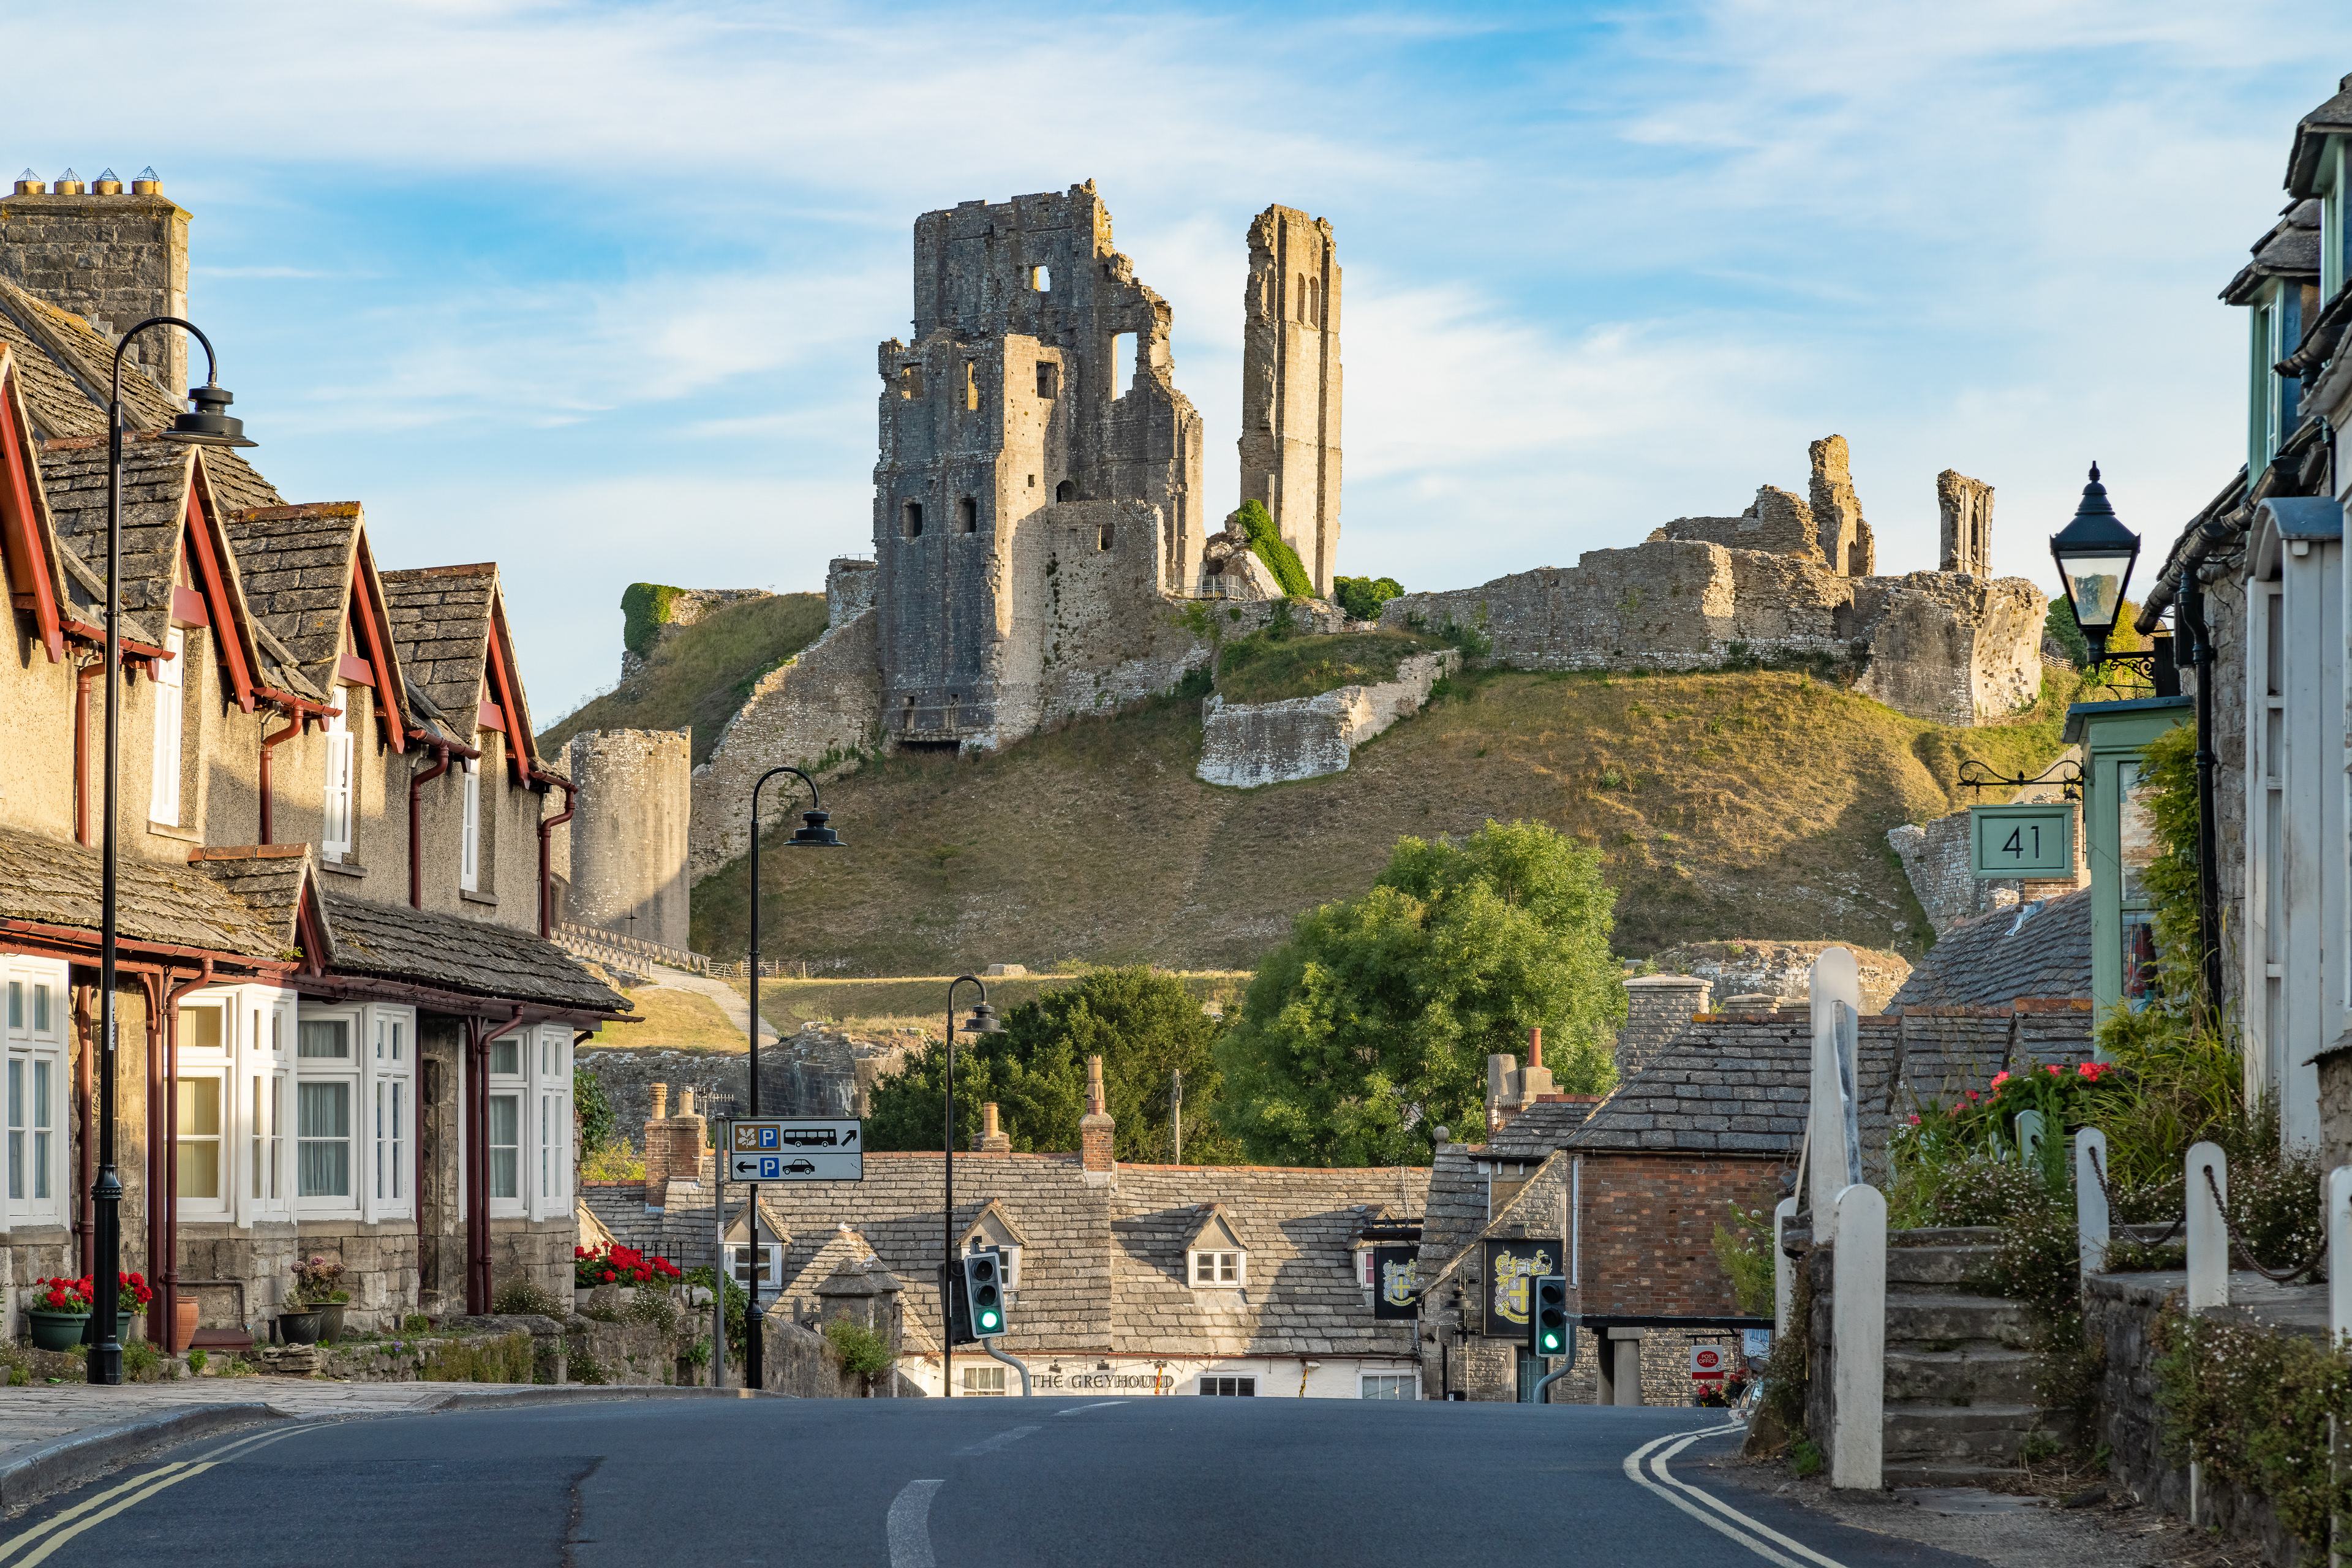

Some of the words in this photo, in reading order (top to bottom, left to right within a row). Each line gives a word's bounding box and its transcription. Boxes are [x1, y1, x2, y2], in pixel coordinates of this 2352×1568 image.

[2002, 825, 2040, 859] 41
[763, 1130, 774, 1146] P
[764, 1160, 775, 1175] P
[1030, 1374, 1063, 1388] THE
[1072, 1374, 1175, 1389] GREYHOUND
